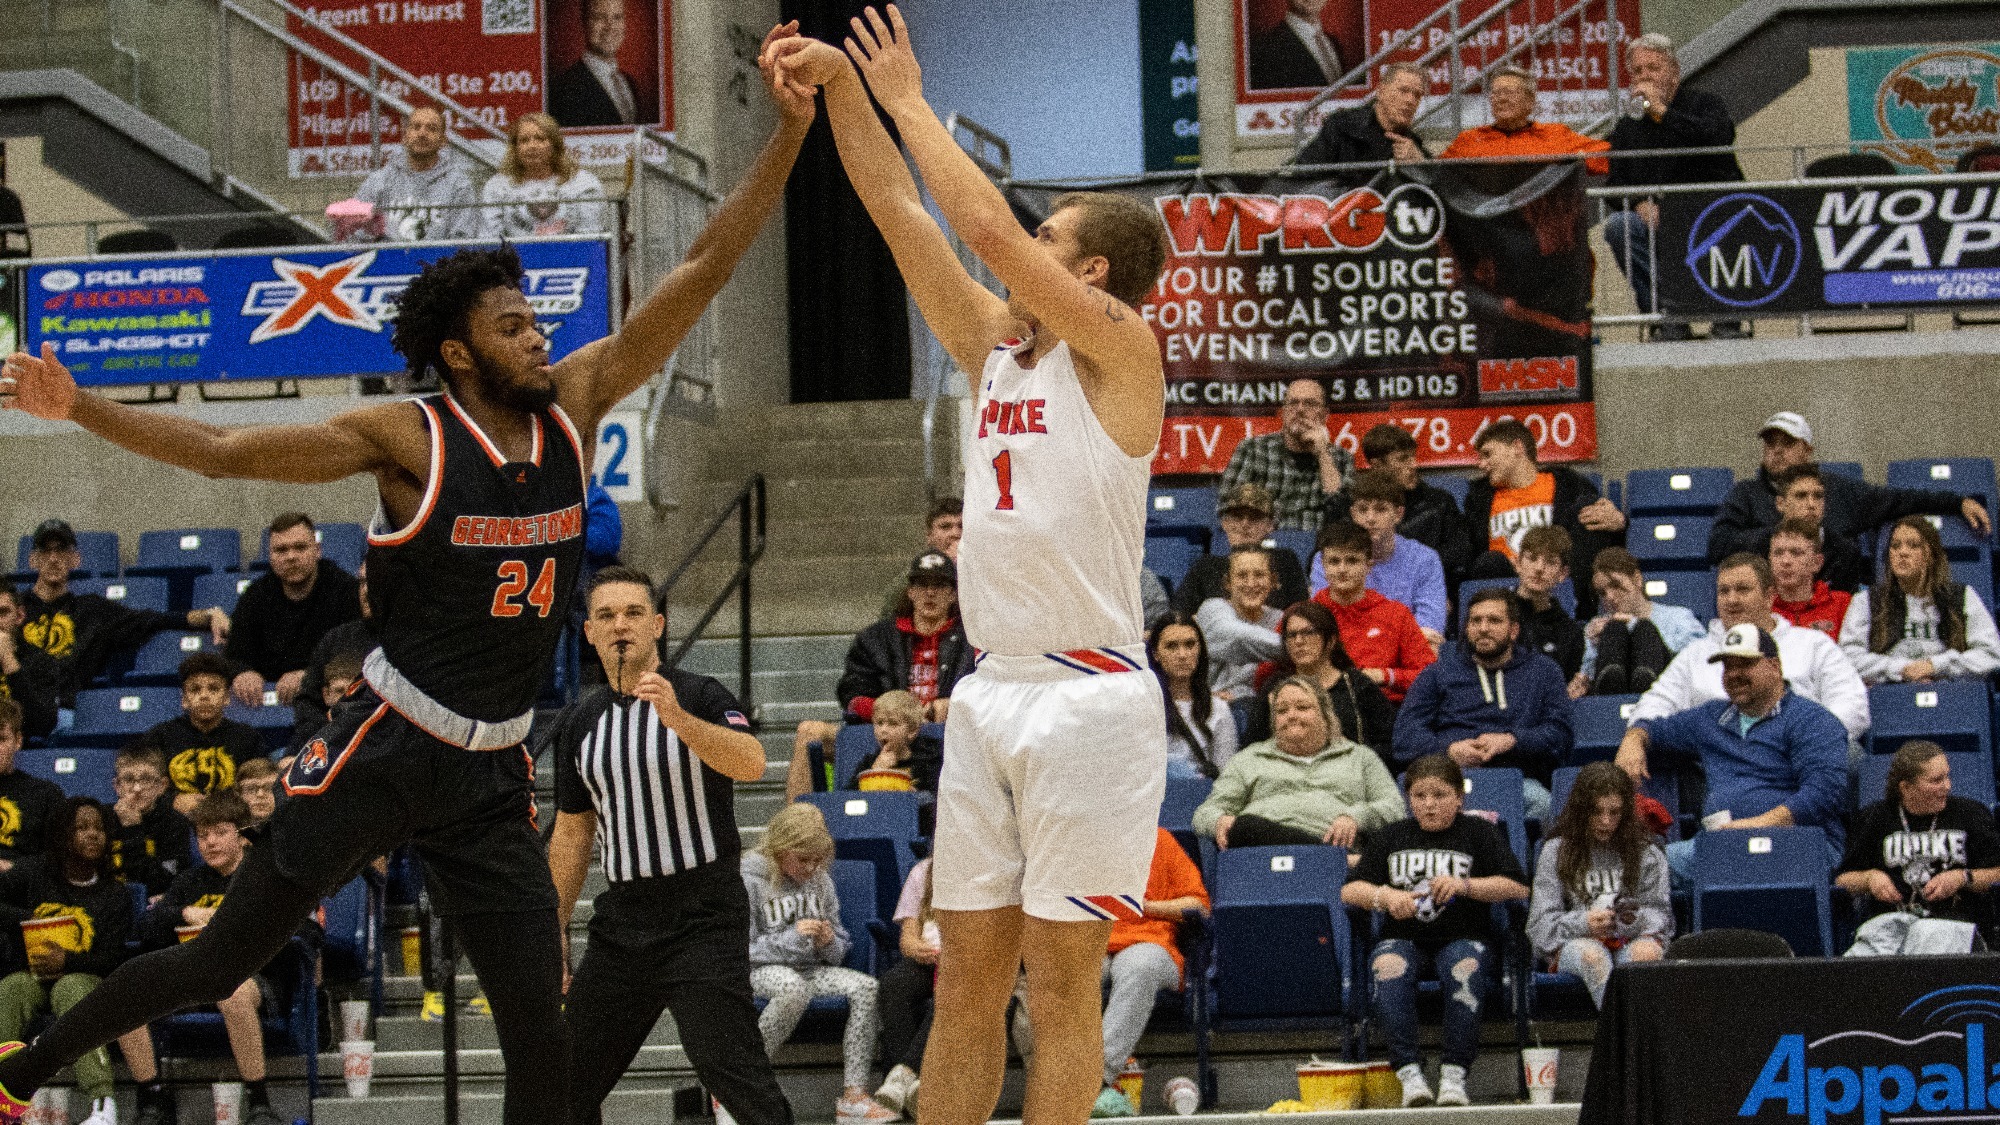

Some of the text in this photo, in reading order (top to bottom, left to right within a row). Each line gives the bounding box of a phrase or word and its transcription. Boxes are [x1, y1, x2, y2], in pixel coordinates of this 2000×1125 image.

[376, 3, 397, 24] TJ
[403, 1, 466, 22] Hurst
[446, 73, 484, 95] Ste
[489, 70, 539, 94] 200,
[1156, 189, 1435, 257] WPRG tv
[1814, 187, 2000, 226] MOU
[84, 266, 206, 287] POLARIS
[1157, 258, 1455, 297] YOUR #1 SOURCE
[72, 287, 210, 310] HONDA
[1141, 290, 1469, 329] FOR LOCAL SPORTS
[40, 309, 212, 334] Kawasaki
[65, 333, 212, 353] SLINGSHOT
[1166, 324, 1477, 362] EVENT COVERAGE
[1204, 381, 1289, 404] CHANN
[1331, 378, 1344, 400] 5
[1354, 377, 1371, 399] &
[1379, 375, 1458, 398] HD105
[992, 449, 1014, 510] 1
[490, 557, 556, 618] 24
[1884, 829, 1967, 868] UPIKE
[1387, 849, 1474, 886] UPIKE
[764, 892, 824, 927] UPIK
[1737, 1022, 2000, 1125] Appal
